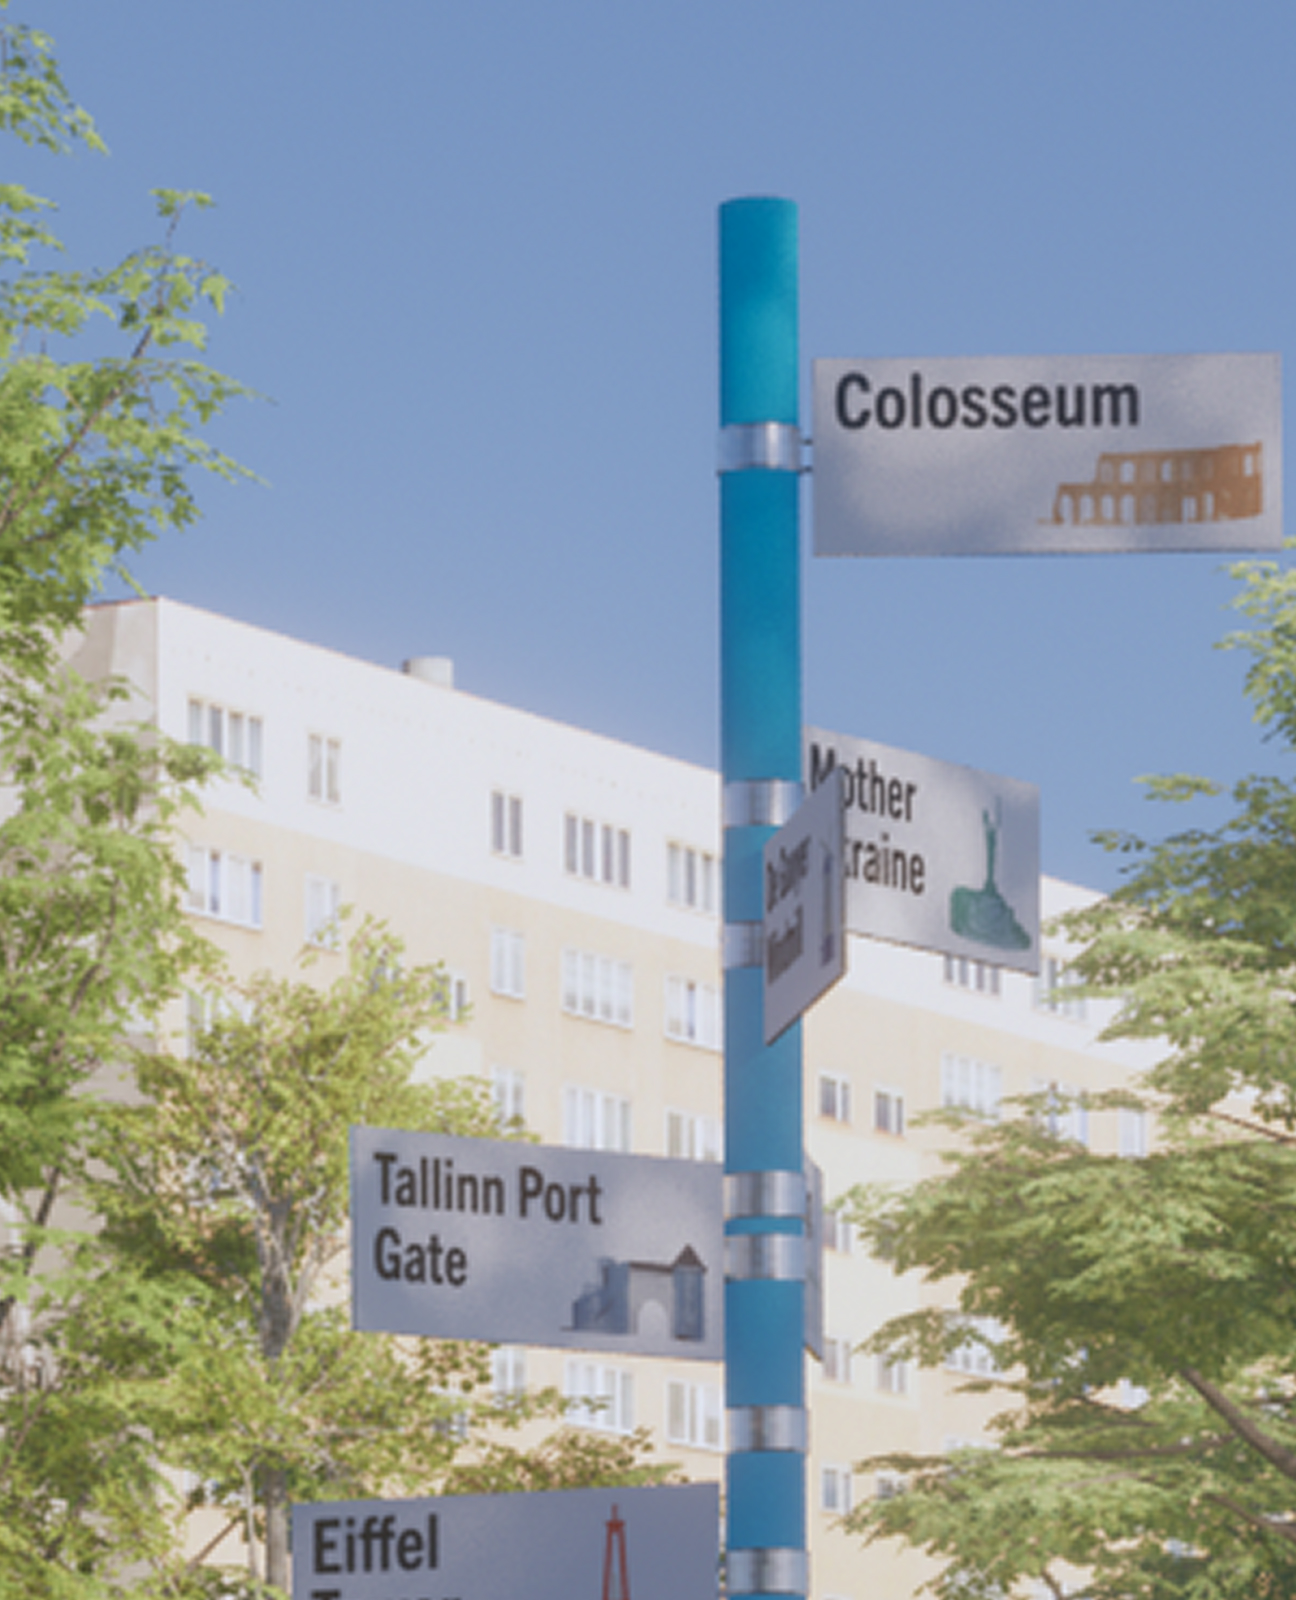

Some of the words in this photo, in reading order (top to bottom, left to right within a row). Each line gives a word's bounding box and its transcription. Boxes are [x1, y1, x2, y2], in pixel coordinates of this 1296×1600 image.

[835, 371, 1139, 430] Colosseum
[845, 832, 925, 894] raine
[374, 1152, 505, 1215] Tallinn
[519, 1166, 602, 1225] Port
[374, 1226, 467, 1286] Gate
[313, 1513, 438, 1575] Eiffel
